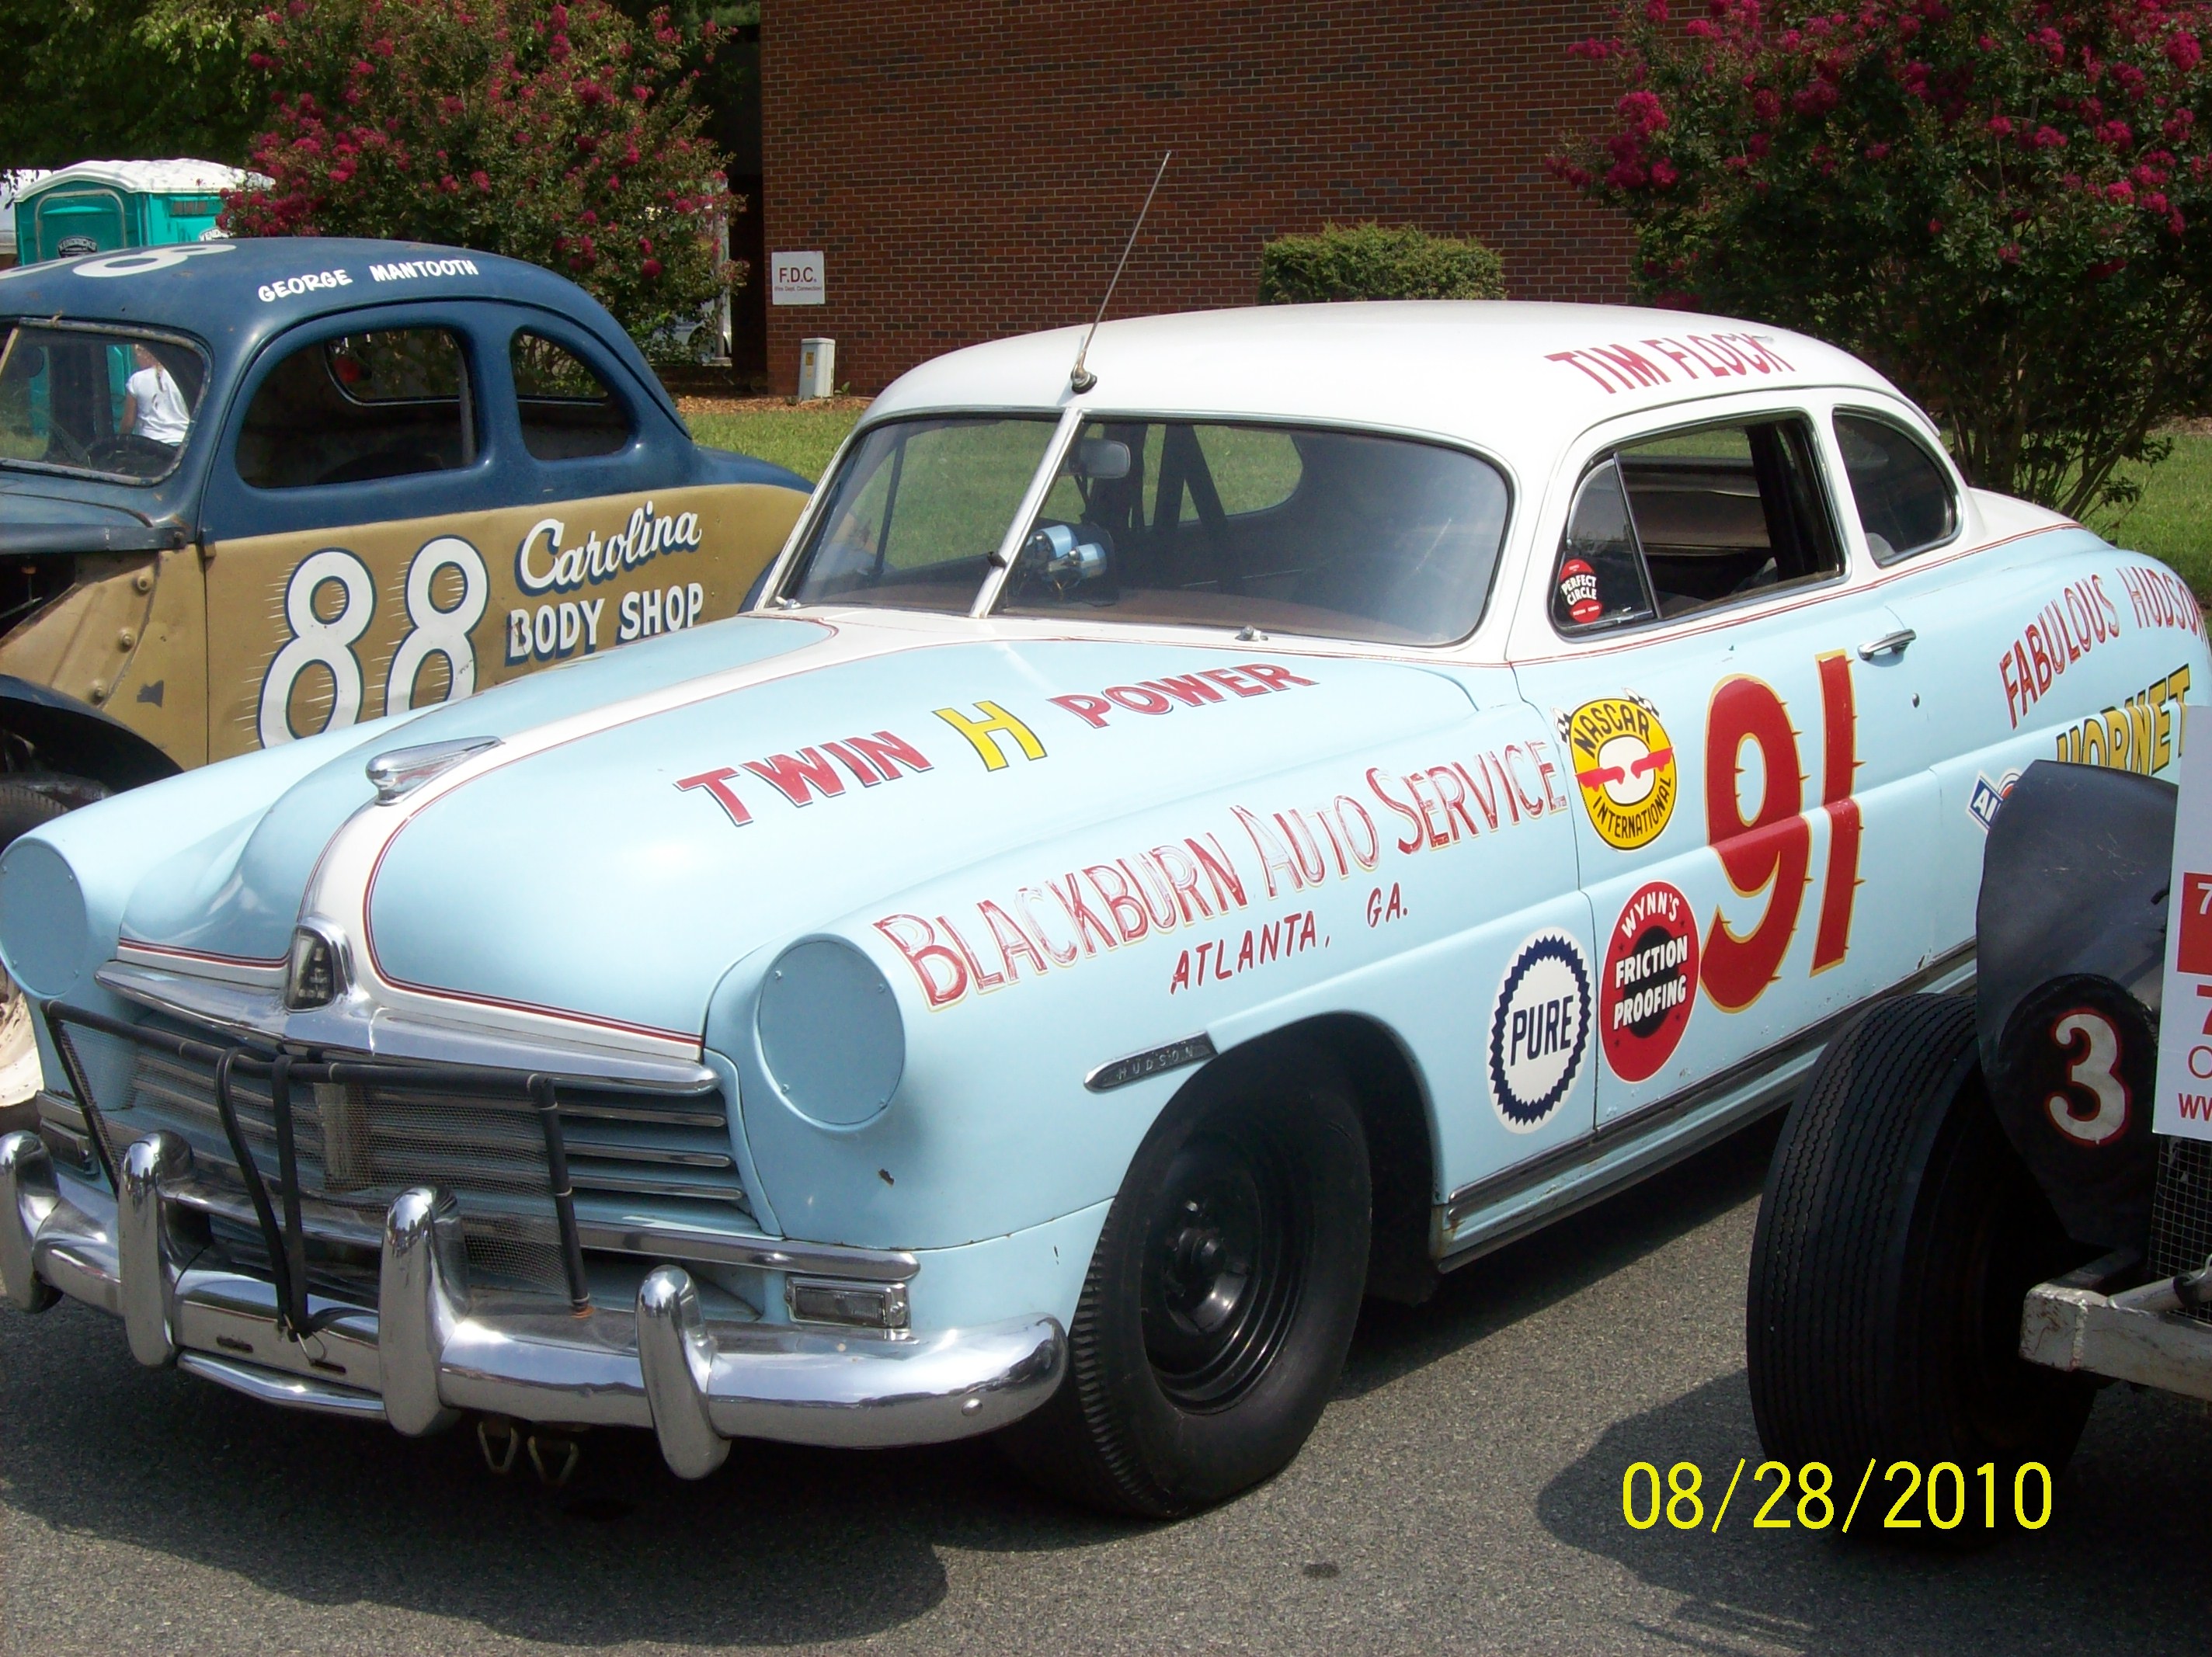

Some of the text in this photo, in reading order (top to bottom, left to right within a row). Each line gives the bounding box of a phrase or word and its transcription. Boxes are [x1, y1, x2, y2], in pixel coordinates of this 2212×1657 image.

[258, 259, 479, 302] GEORGE MANTOOTH
[779, 266, 817, 283] F.D.C.
[1543, 333, 1796, 394] TIM FLOCK
[518, 500, 702, 592] Carolina
[1560, 574, 1597, 596] PERFECT
[1567, 586, 1597, 606] CIRCLE
[257, 535, 489, 748] 88
[506, 582, 704, 663] BODY SHOP
[1999, 574, 2120, 731] FABULOUS
[673, 664, 1321, 827] TWIN H POWER
[1574, 703, 1650, 759] NASCAR
[1592, 776, 1671, 839] INTERNATIONAL
[1699, 648, 1866, 1014] 91
[871, 739, 1570, 1012] BLACKBURN AUTO SERVICE
[1170, 881, 1410, 994] ATLANTA, GA.
[1621, 891, 1680, 939] WYNN'S
[1615, 934, 1689, 989] FRICTION
[1510, 994, 1574, 1067] PURE
[1612, 974, 1687, 1031] PROOFING
[1117, 1045, 1194, 1081] HUDSON
[2047, 1009, 2130, 1145] 3
